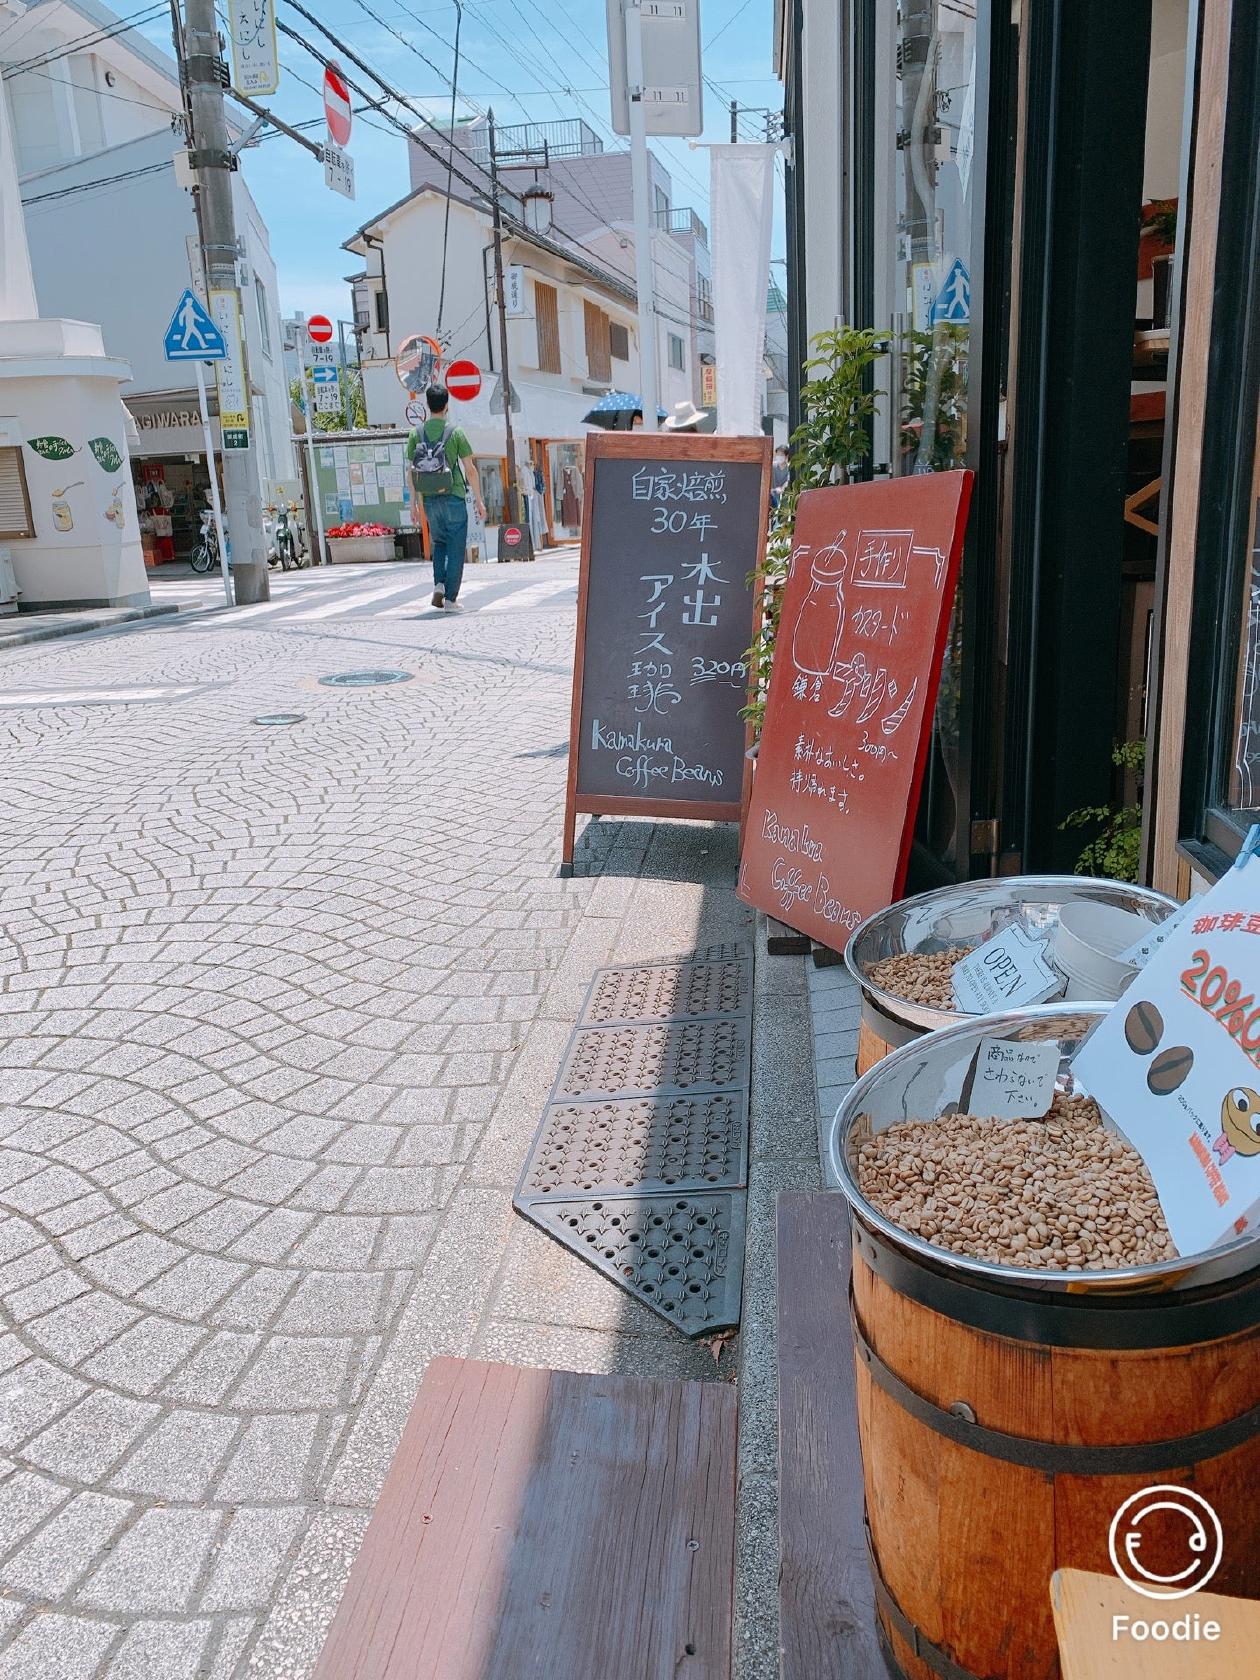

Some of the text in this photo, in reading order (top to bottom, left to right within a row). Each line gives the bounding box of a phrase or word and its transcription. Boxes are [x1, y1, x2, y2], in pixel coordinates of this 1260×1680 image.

[312, 354, 334, 363] 7-19
[317, 392, 339, 402] 7-19
[650, 507, 718, 542] 30年
[681, 553, 731, 626] 水出
[690, 657, 746, 680] 320円
[592, 719, 674, 754] Kamakura
[616, 755, 724, 789] Coffee Beans
[771, 857, 861, 931] Coffee Beans
[983, 947, 1027, 998] OPEN
[983, 1066, 1048, 1089] さわらないで
